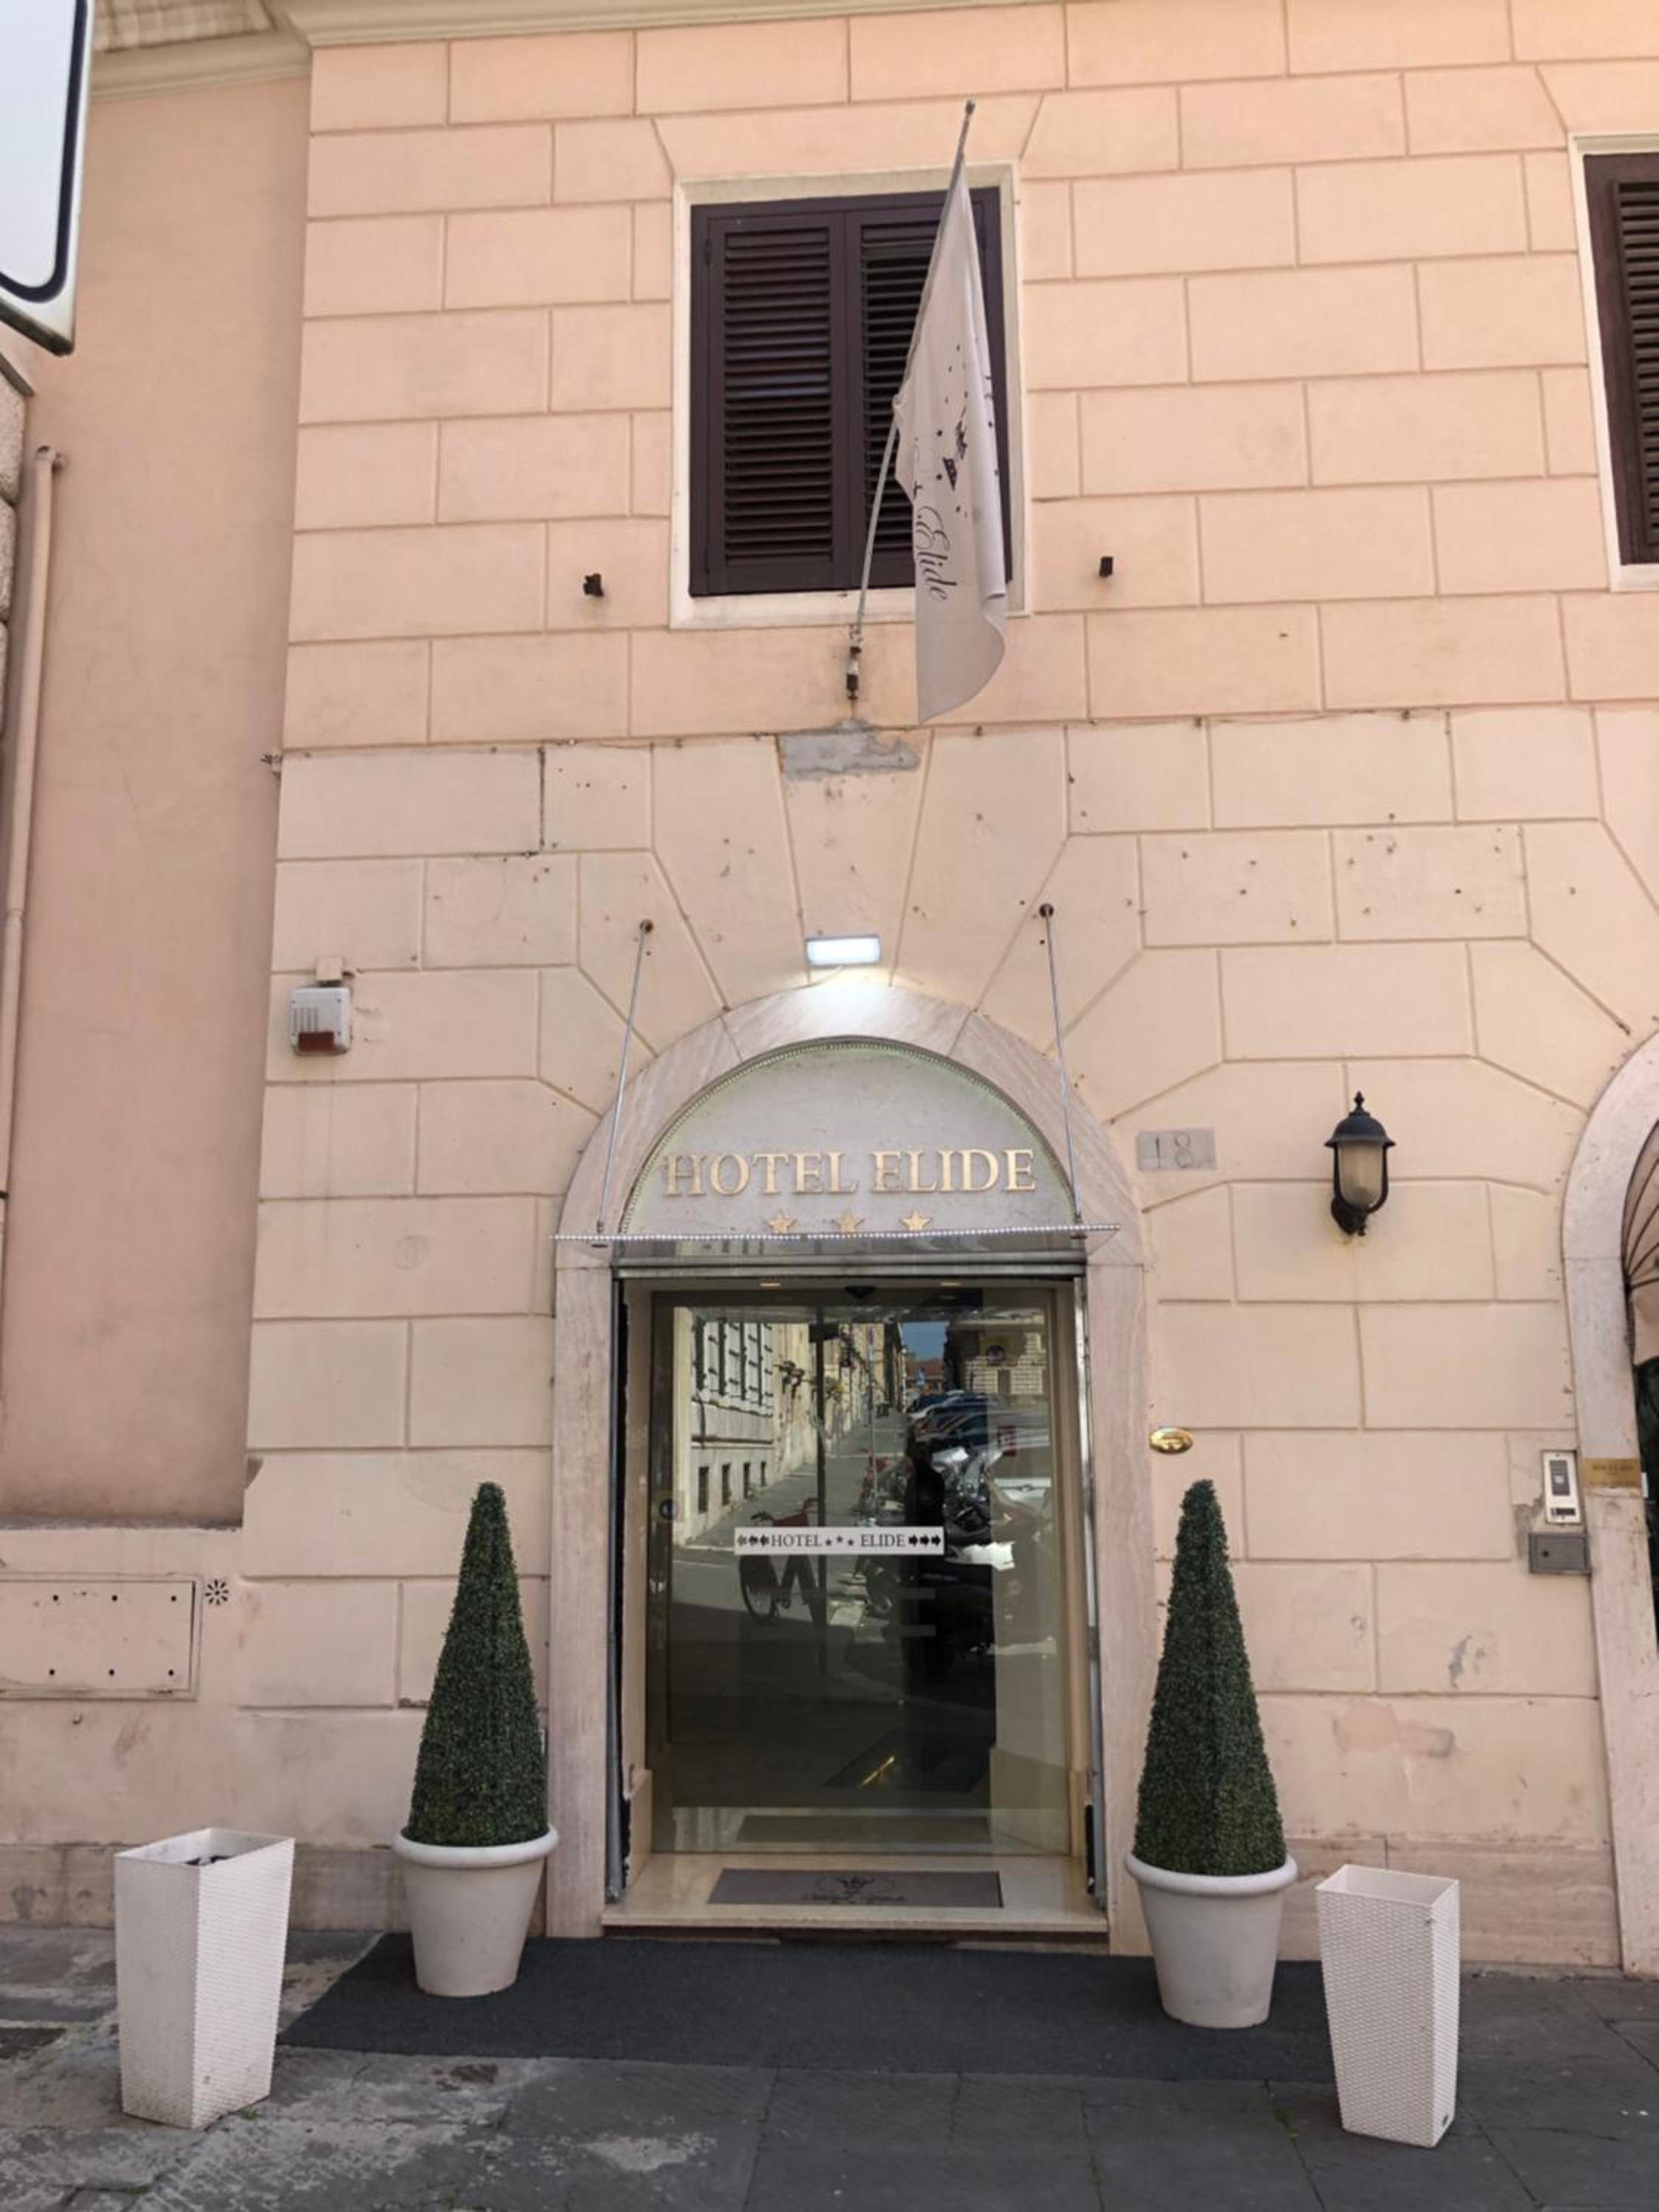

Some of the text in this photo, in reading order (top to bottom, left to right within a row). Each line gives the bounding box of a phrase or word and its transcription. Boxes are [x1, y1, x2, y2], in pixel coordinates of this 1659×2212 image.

[1155, 1132, 1192, 1169] 18
[664, 1148, 1038, 1197] HOTEL ELIDE
[771, 1534, 906, 1547] HOTEL ELIDE
